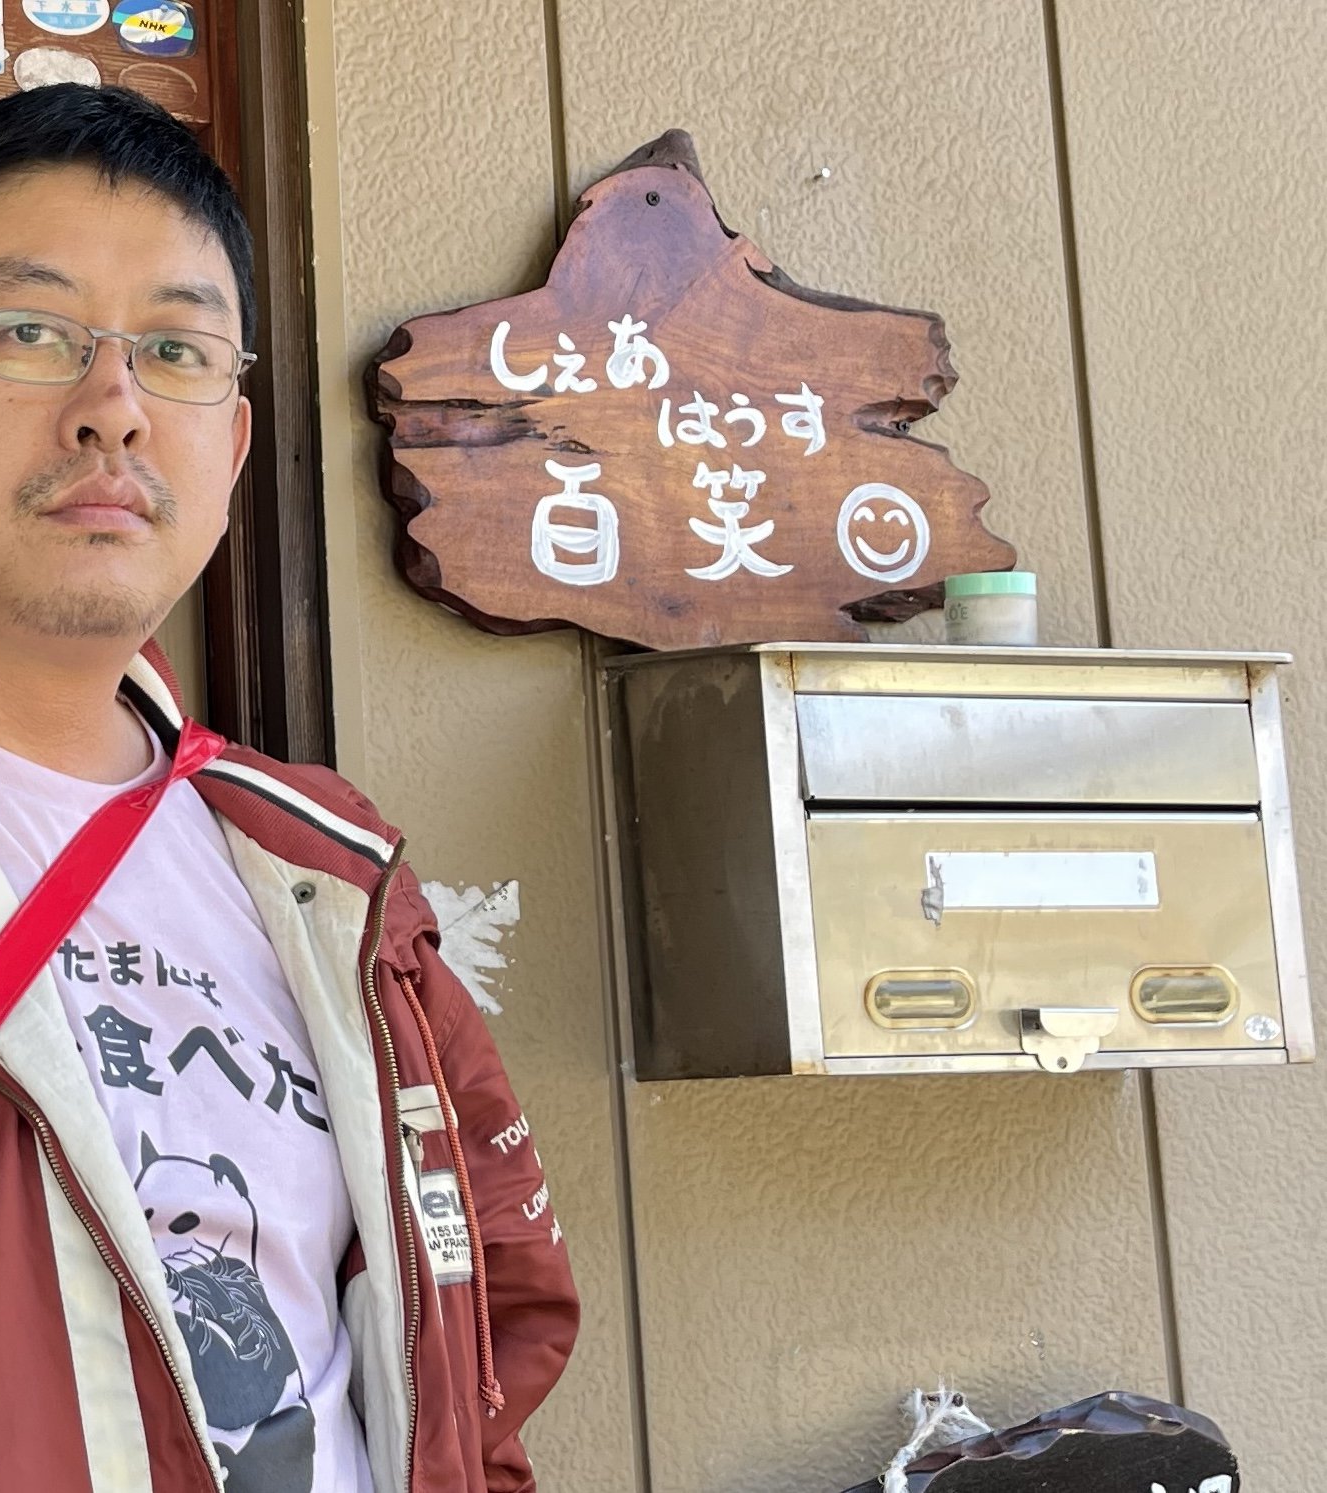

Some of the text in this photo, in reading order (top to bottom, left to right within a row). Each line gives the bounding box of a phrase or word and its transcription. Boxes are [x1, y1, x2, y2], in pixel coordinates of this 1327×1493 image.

[138, 19, 167, 32] NHK
[489, 314, 670, 393] しぇあ
[657, 381, 826, 456] はうす
